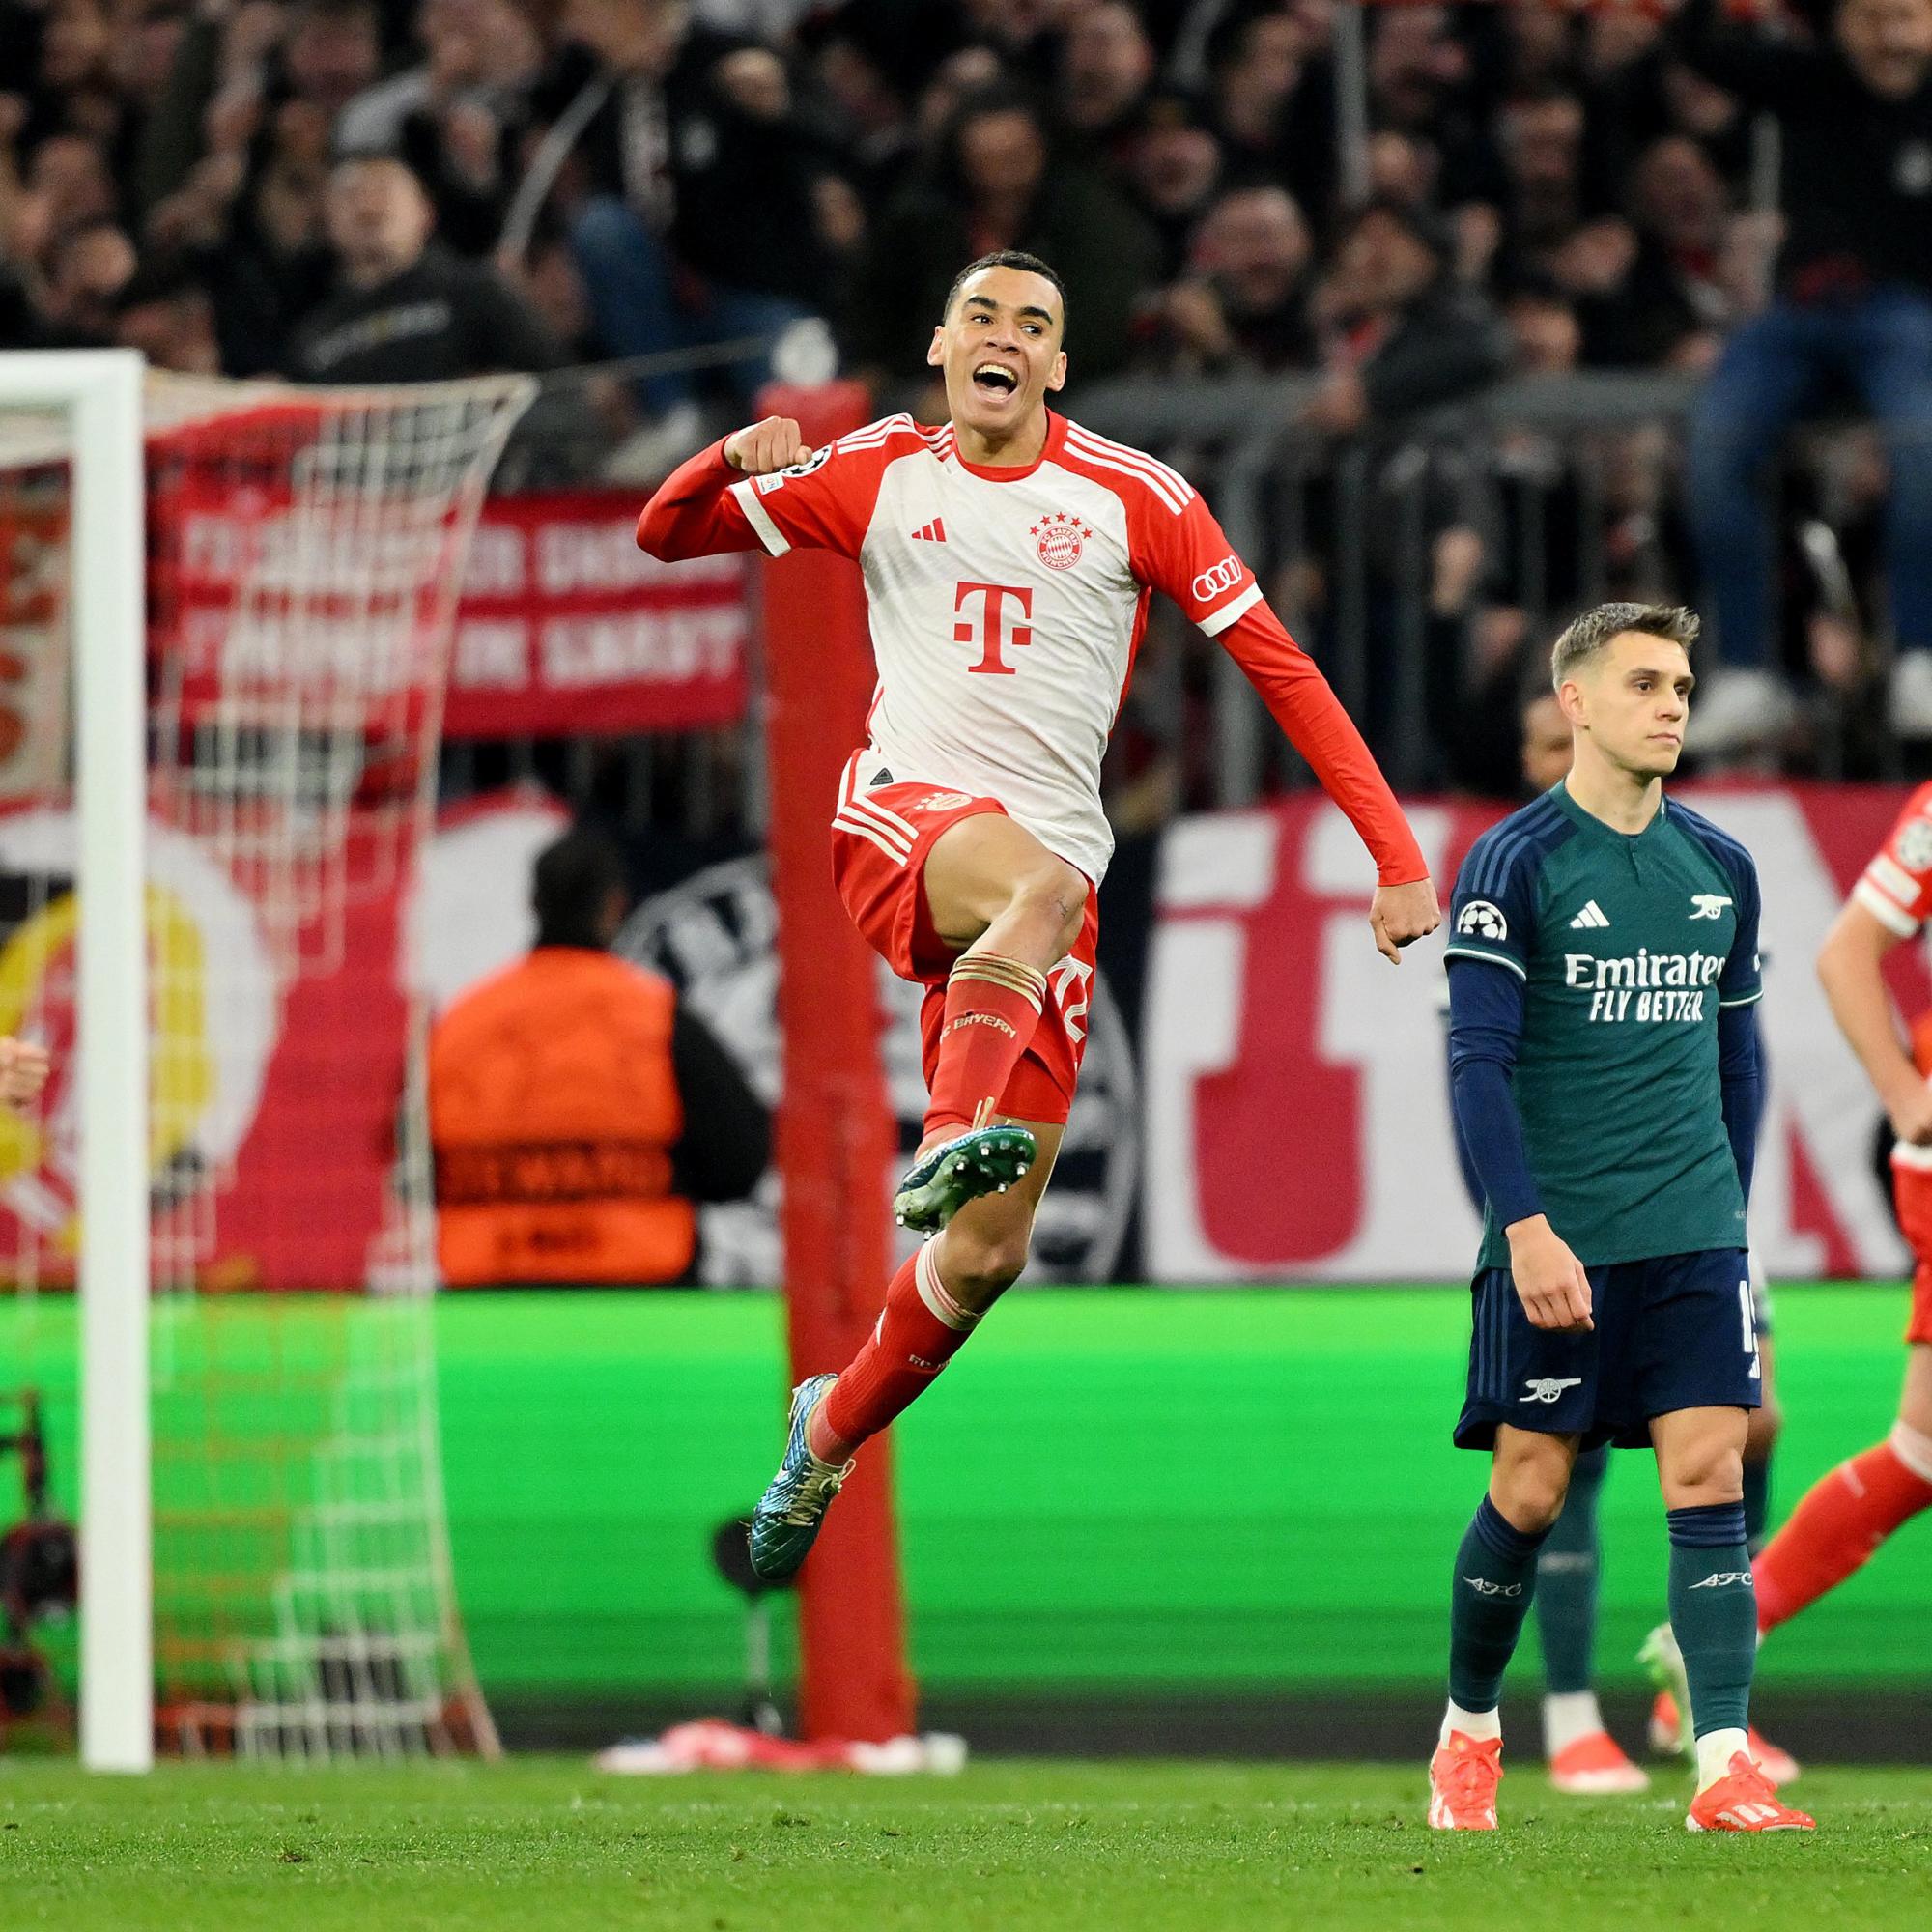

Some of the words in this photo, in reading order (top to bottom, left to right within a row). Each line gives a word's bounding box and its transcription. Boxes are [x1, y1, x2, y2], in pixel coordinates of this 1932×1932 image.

[1589, 990, 1633, 1022] FLY
[1635, 990, 1704, 1022] BETTER
[953, 1013, 1017, 1039] BAYERN
[1687, 1571, 1753, 1590] AFC
